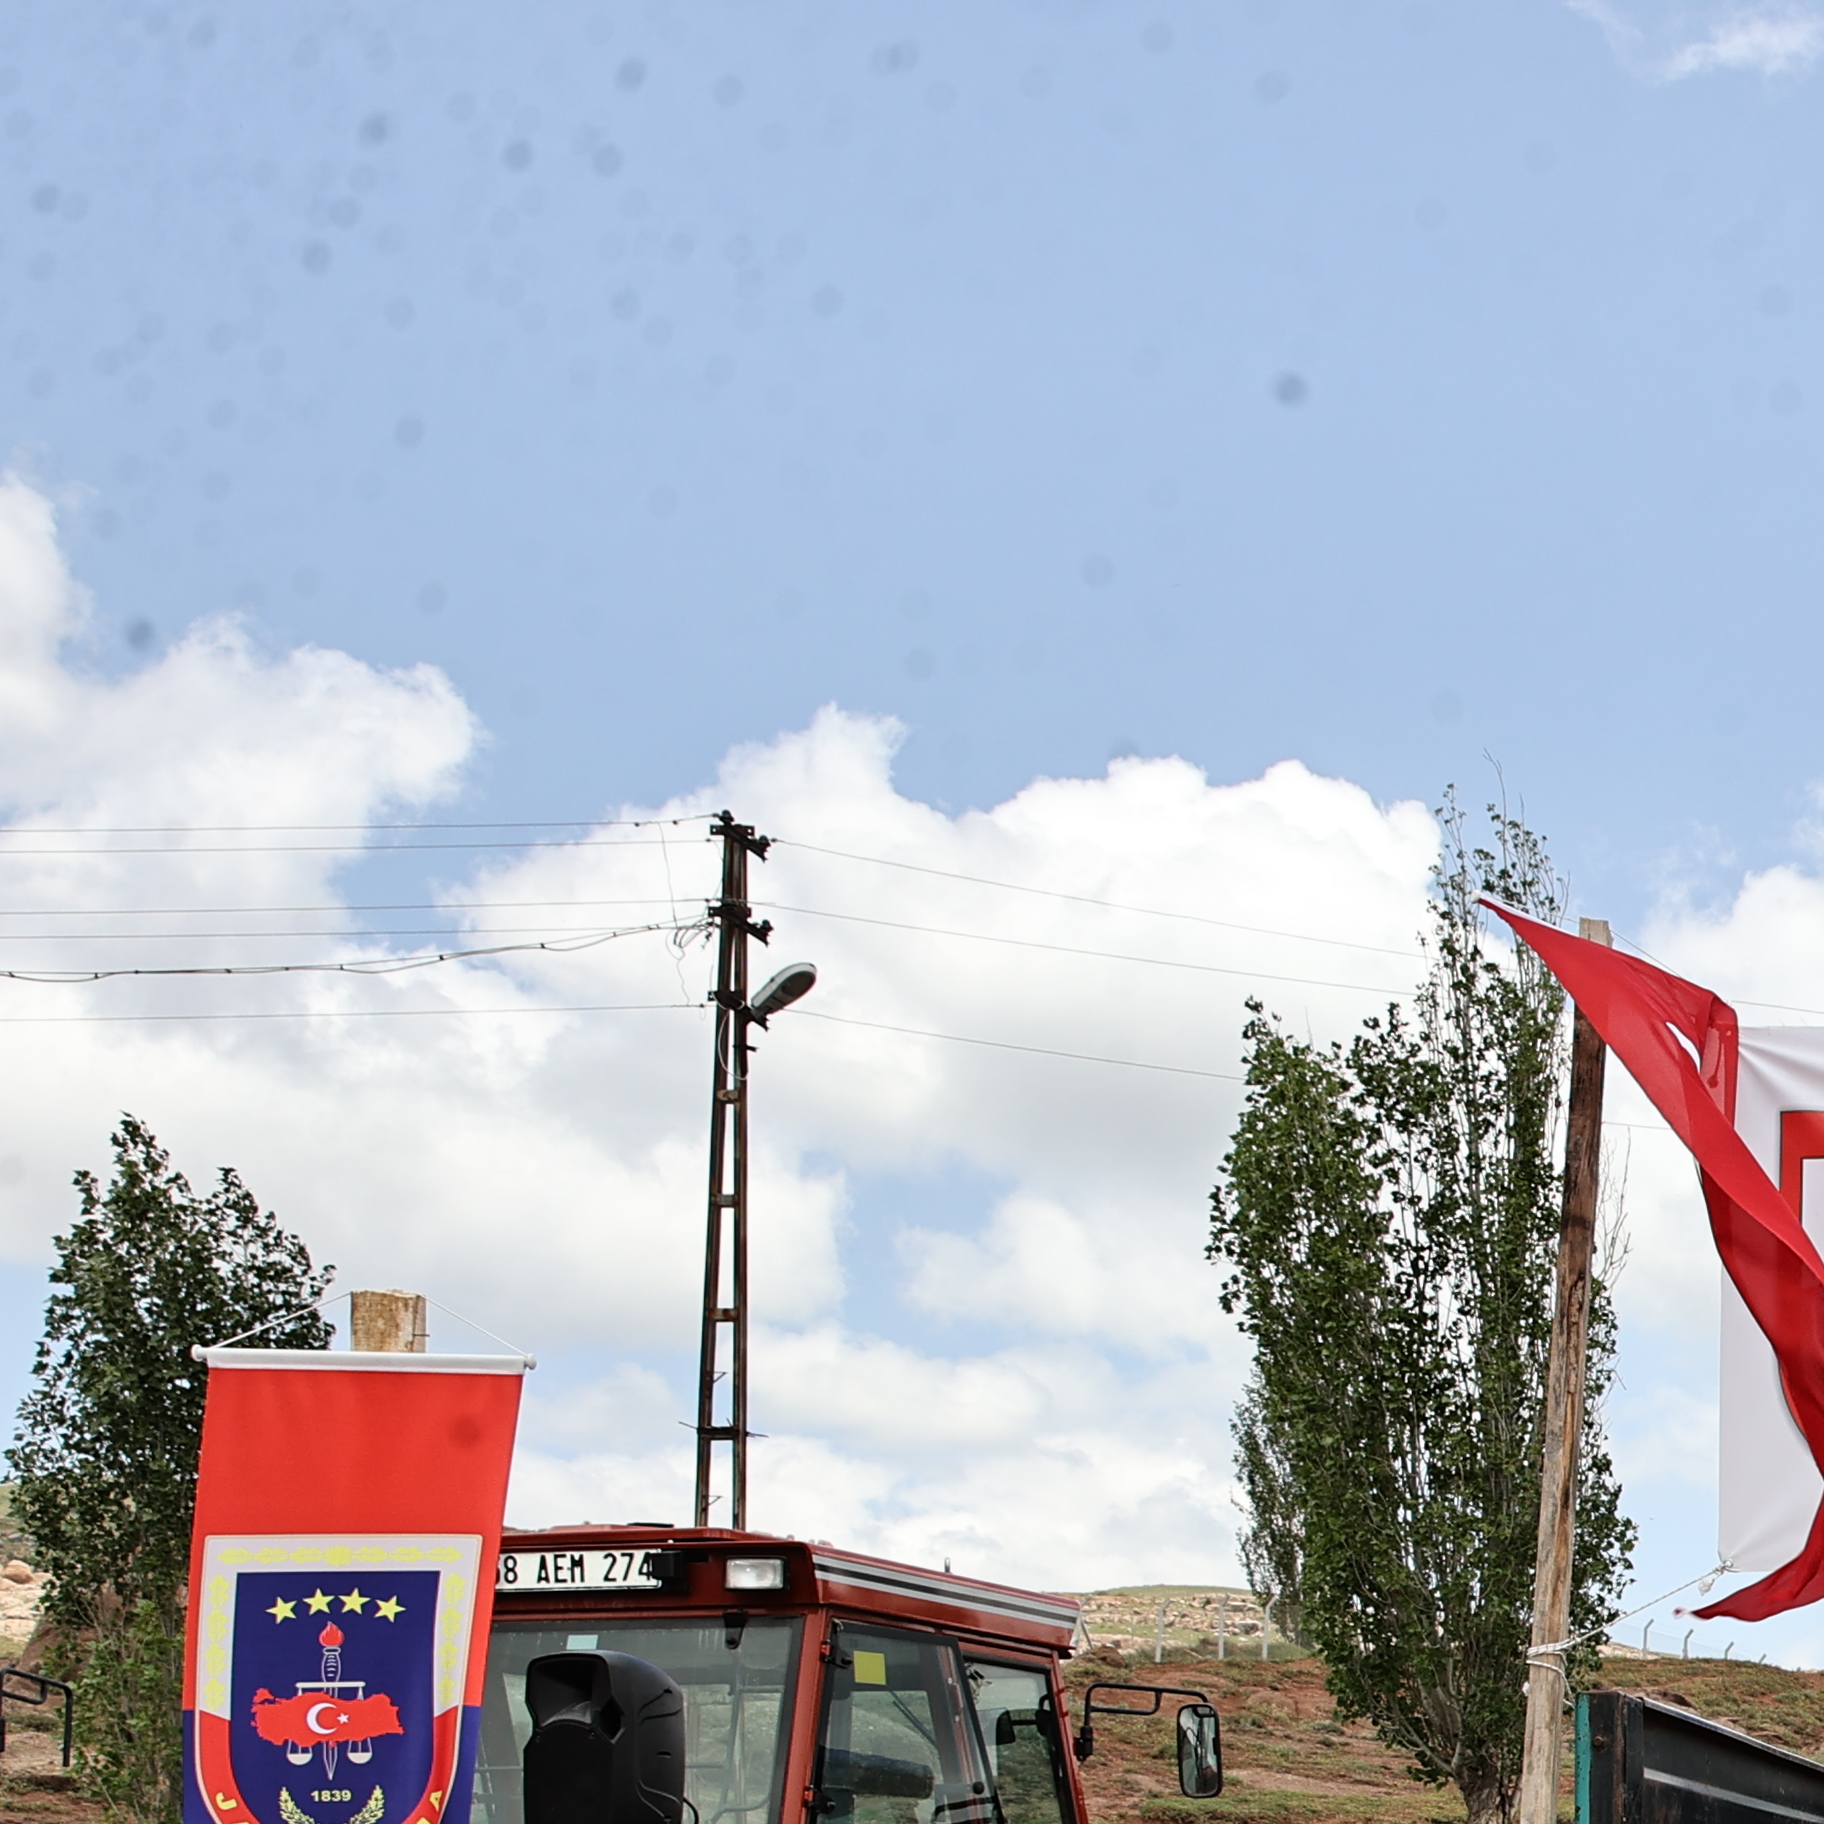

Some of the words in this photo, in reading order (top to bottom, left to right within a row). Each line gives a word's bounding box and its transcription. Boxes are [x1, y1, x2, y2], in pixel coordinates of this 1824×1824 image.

[497, 1555, 518, 1584] 8
[536, 1554, 585, 1584] AEM
[602, 1552, 652, 1582] 274
[310, 1789, 352, 1802] 1839
